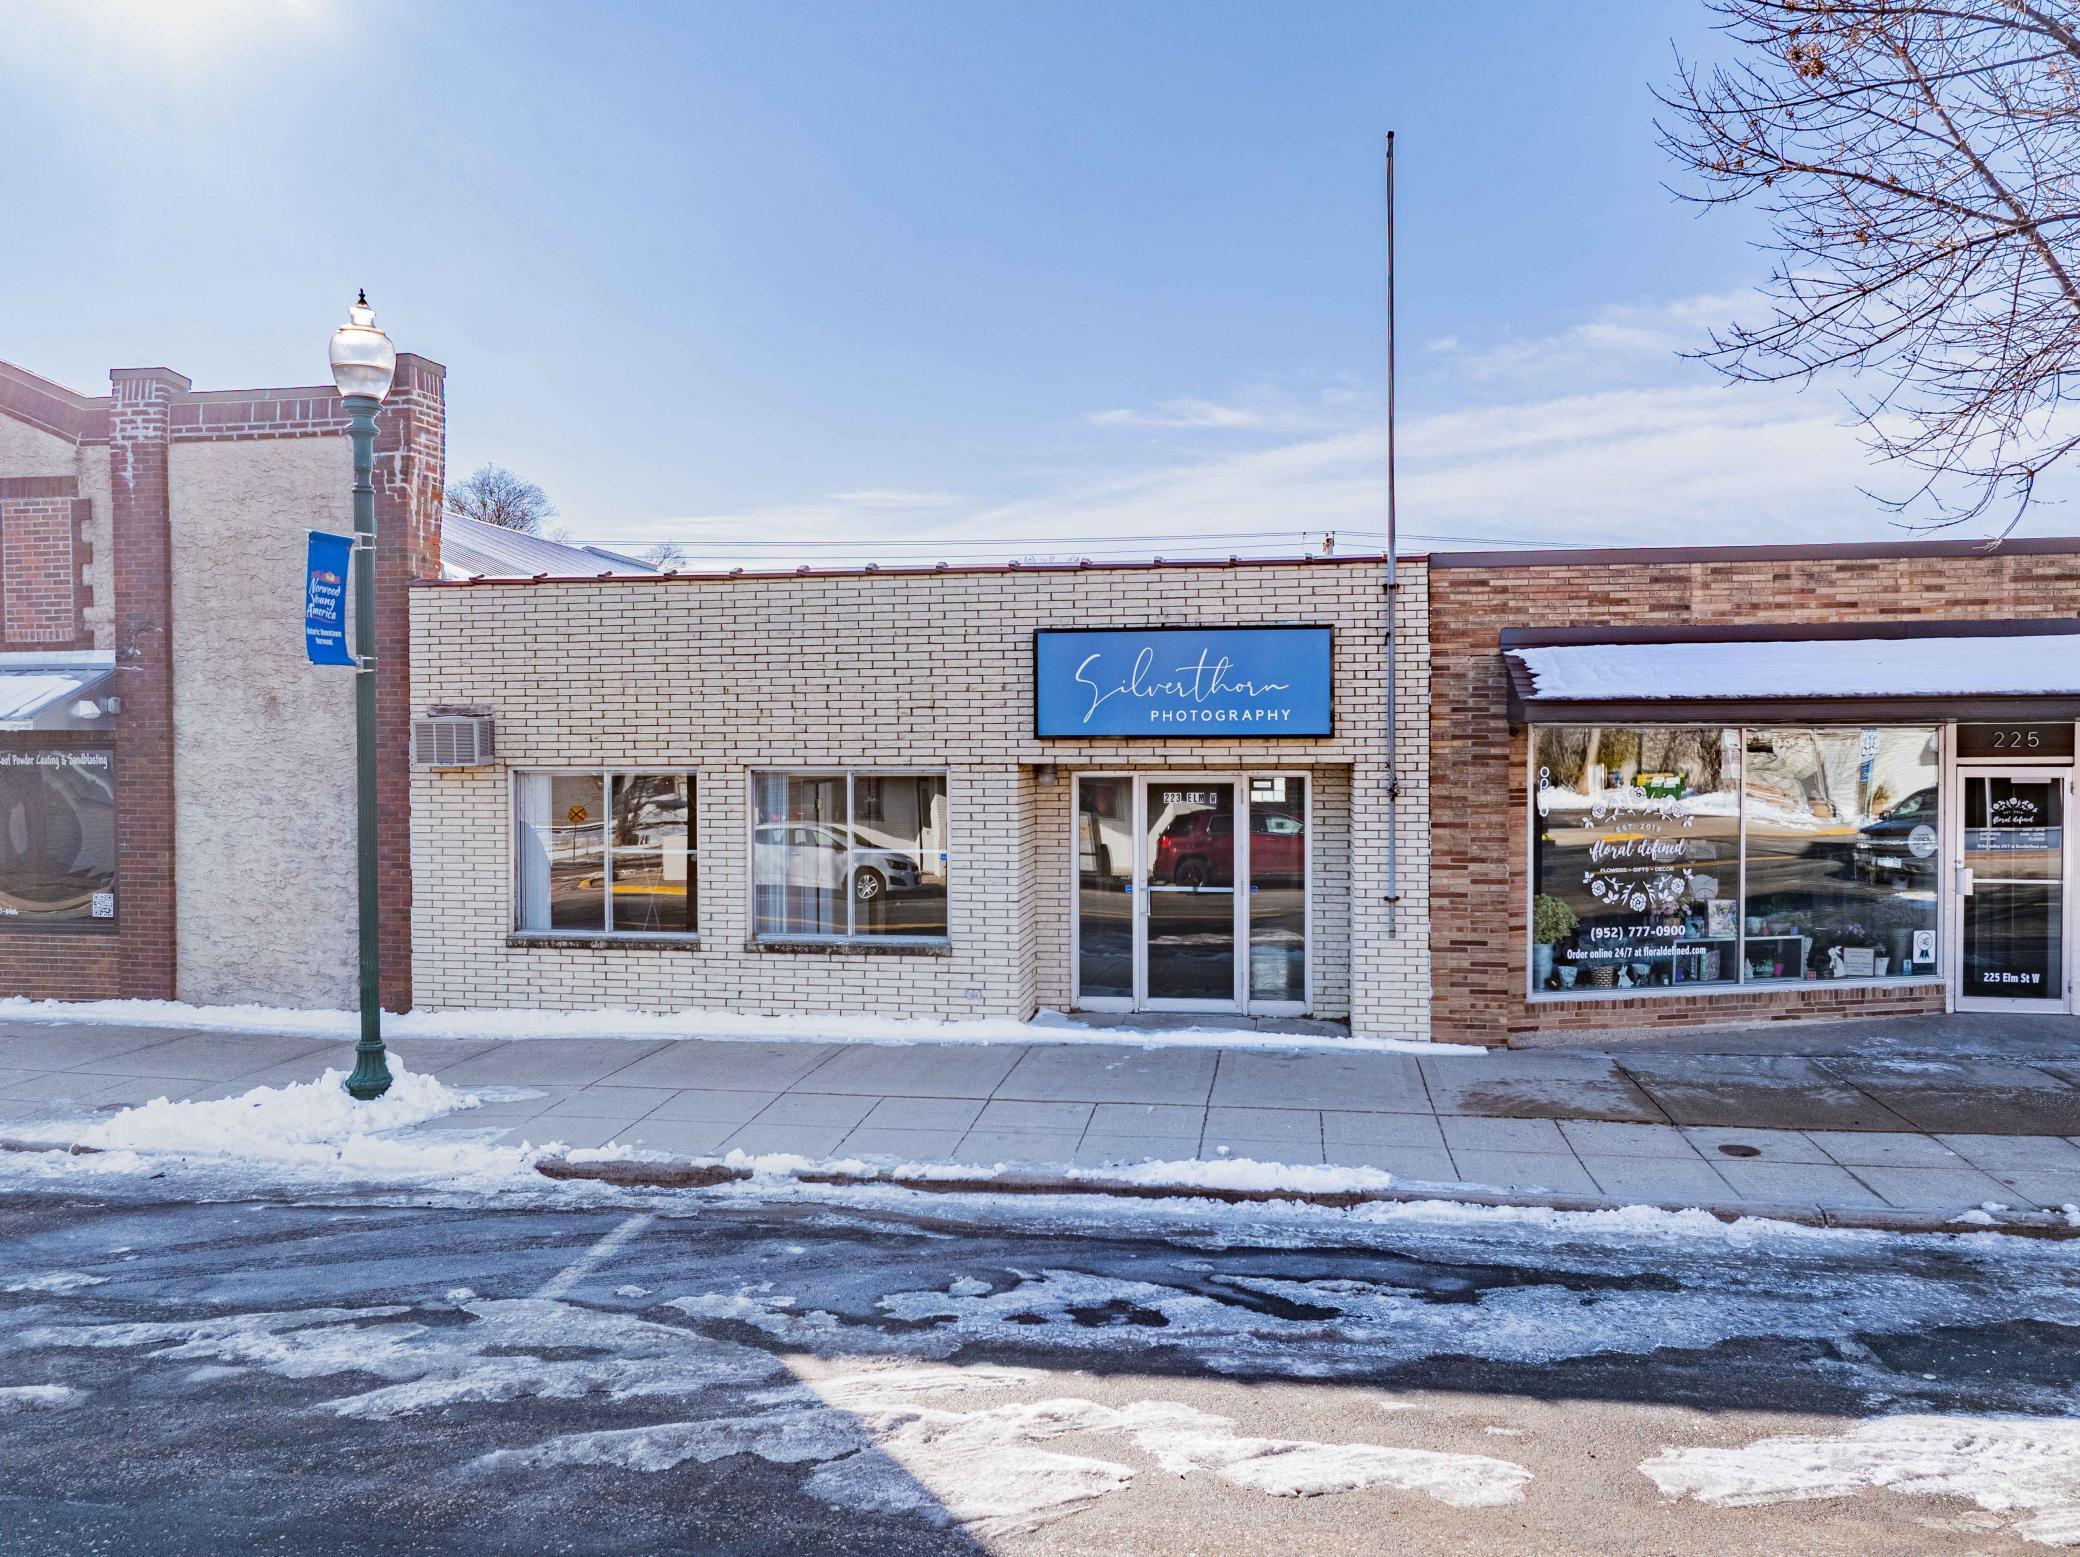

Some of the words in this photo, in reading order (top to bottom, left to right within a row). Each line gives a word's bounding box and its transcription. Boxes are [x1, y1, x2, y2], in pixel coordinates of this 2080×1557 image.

[309, 578, 341, 597] Norwood
[311, 593, 336, 611] Young
[306, 603, 337, 620] America
[1075, 647, 1290, 723] Silverthorn
[1150, 709, 1292, 722] PHOTOGRAPHY
[1993, 731, 2040, 748] 225
[12, 754, 35, 767] Powder
[36, 754, 60, 770] Coating
[61, 755, 67, 766] &
[68, 753, 108, 770] Sandblasting
[1164, 793, 1181, 803] 223
[1187, 793, 1205, 803] ELM
[1210, 793, 1216, 803] W
[1616, 823, 1637, 833] EST.
[1589, 839, 1635, 862] floral
[1637, 838, 1686, 861] defined
[1590, 926, 1623, 941] (952)
[1628, 925, 1686, 937] 777-0900
[1567, 948, 1588, 960] Order
[1590, 948, 1612, 959] online
[1615, 947, 1633, 958] 24/7
[1634, 949, 1642, 957] at
[1644, 945, 1707, 957] floraldefined.com
[1984, 972, 2000, 982] 225
[2002, 972, 2019, 983] Elm
[2020, 972, 2030, 983] St
[2031, 973, 2040, 983] W
